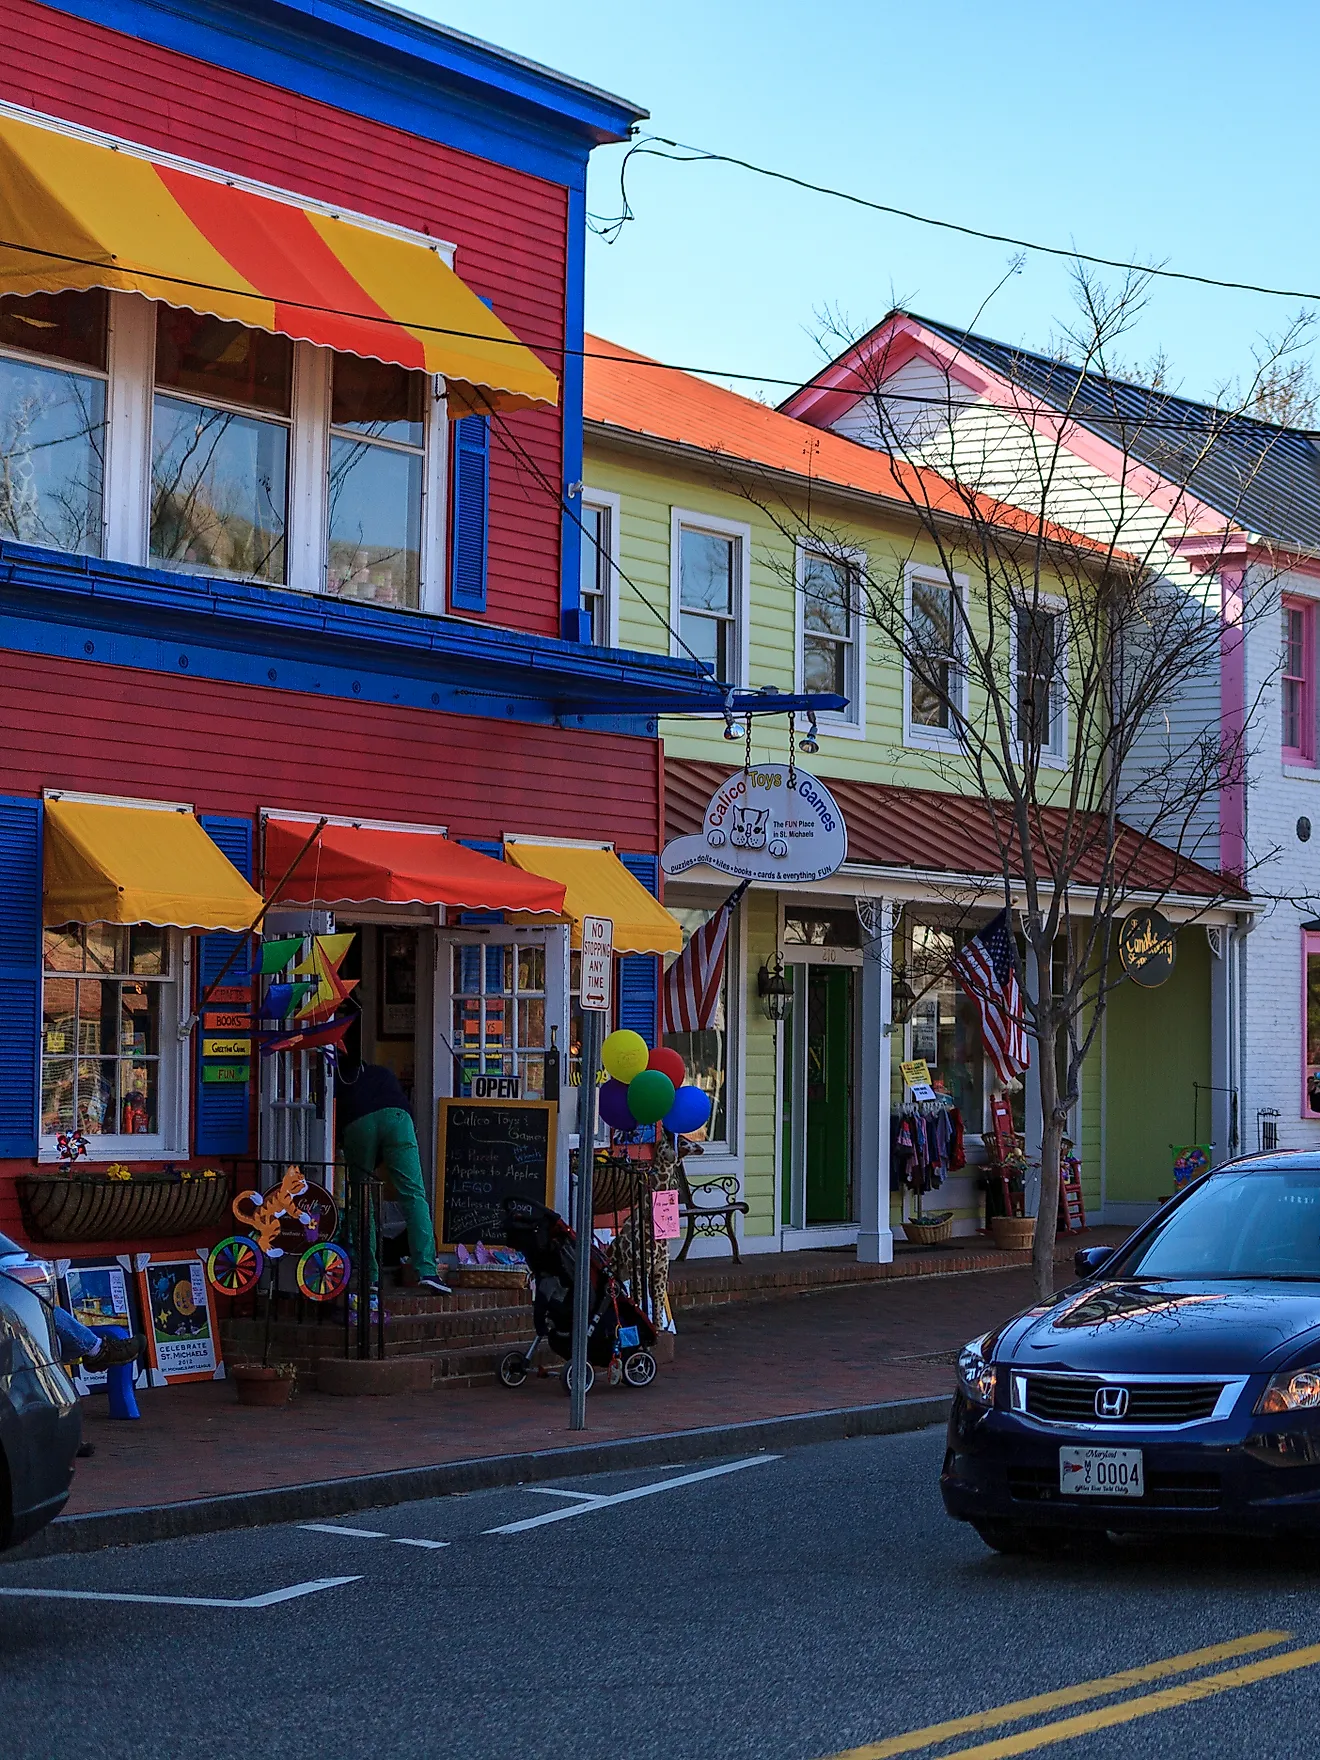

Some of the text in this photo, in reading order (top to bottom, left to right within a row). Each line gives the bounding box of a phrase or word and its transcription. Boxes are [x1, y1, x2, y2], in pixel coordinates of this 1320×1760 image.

[709, 771, 836, 832] Calico Toys & Games
[671, 859, 693, 872] puzzles
[716, 859, 730, 870] kites
[734, 866, 752, 876] books
[783, 871, 816, 880] everything
[818, 866, 832, 876] FUN
[592, 923, 604, 938] NO
[584, 941, 610, 957] STOPPING
[589, 960, 604, 972] ANY
[588, 976, 604, 988] TIME
[216, 1016, 242, 1026] BOOKS
[218, 1069, 234, 1079] FUN
[476, 1078, 518, 1098] OPEN
[452, 1109, 490, 1126] Calico
[493, 1110, 520, 1130] Toys
[508, 1127, 548, 1142] Games
[452, 1164, 539, 1180] Apples to Apples
[453, 1180, 492, 1192] LEGO
[160, 1343, 206, 1352] CELEBRATE
[173, 1350, 208, 1359] MICHAELS
[1086, 1450, 1117, 1460] Maryland
[1098, 1463, 1139, 1486] 0004
